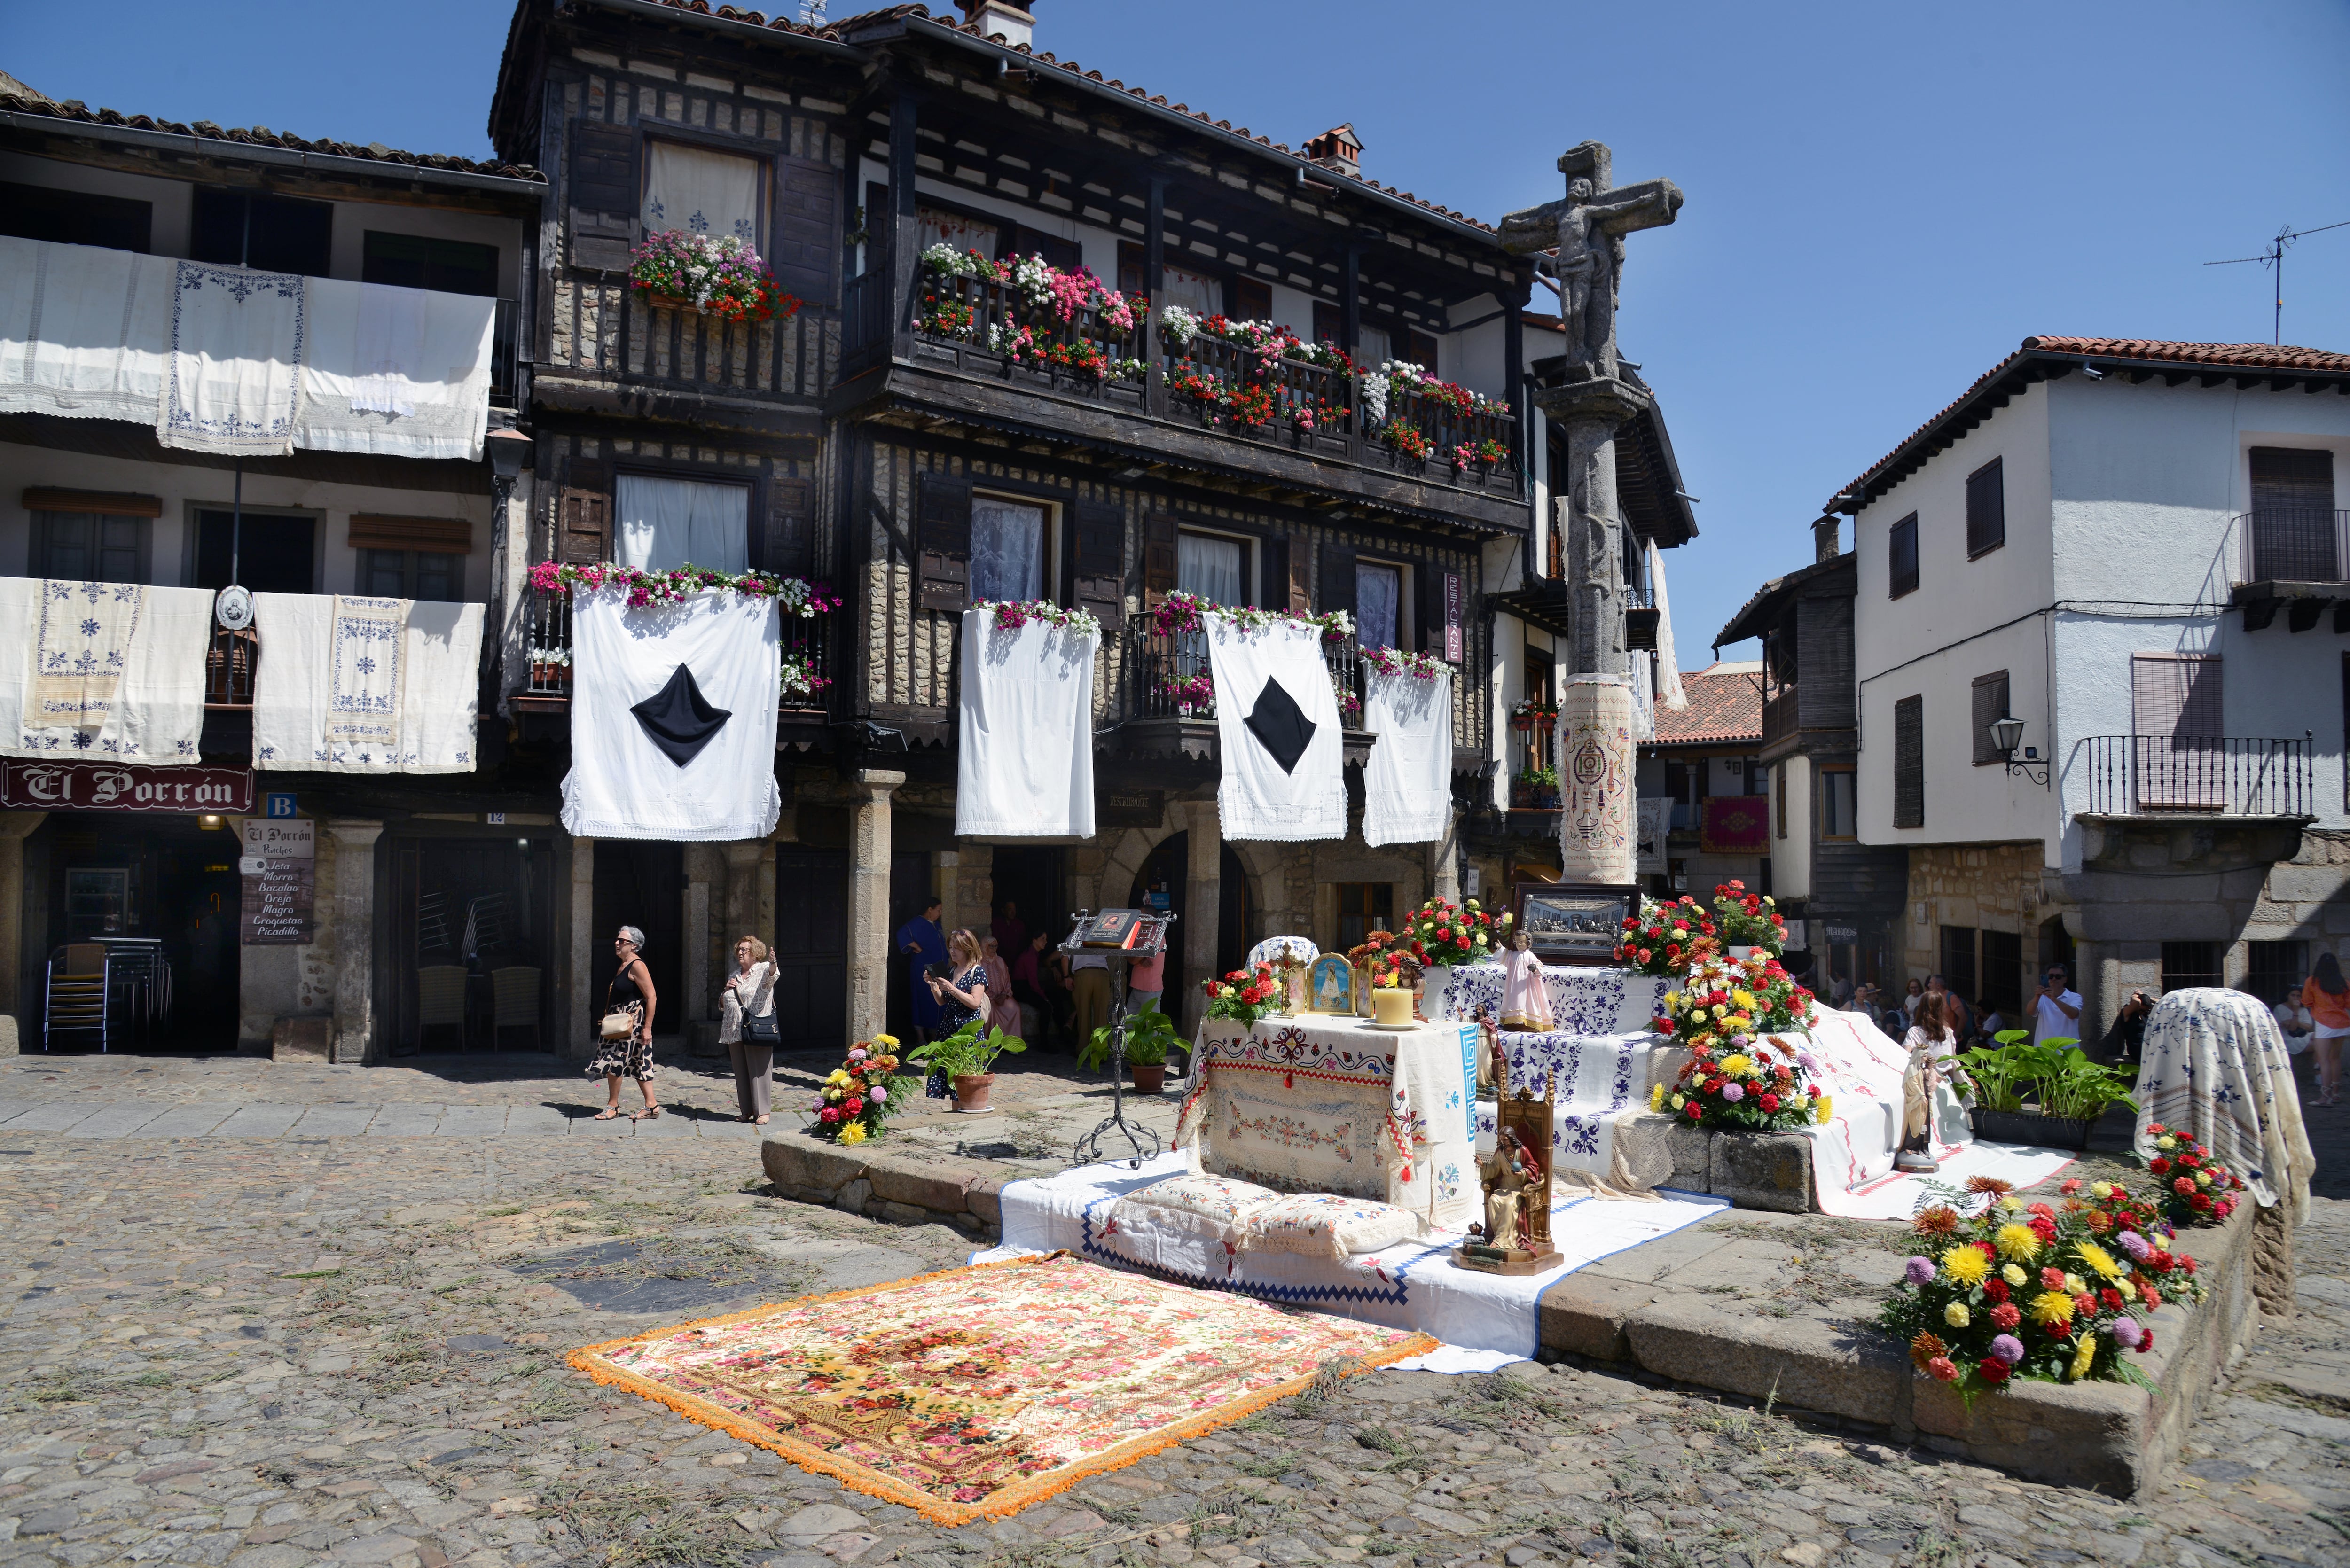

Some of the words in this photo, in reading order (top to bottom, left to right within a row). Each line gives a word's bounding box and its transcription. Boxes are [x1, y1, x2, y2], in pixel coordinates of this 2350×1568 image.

[23, 769, 73, 800] El
[92, 771, 233, 803] Porrón
[273, 797, 291, 815] B
[1110, 796, 1149, 807] RESTAURANTE
[248, 828, 263, 841] El
[268, 828, 311, 842] Porrón
[262, 843, 293, 856] Pinchos
[267, 861, 290, 870] Jeta
[264, 872, 293, 881] Morro
[259, 882, 298, 892] Bacalao
[265, 894, 292, 906] Oreja
[263, 905, 294, 917] Magro
[253, 915, 303, 928] Croquetas
[258, 926, 298, 936] Picadillo
[1826, 926, 1857, 936] MARCOS
